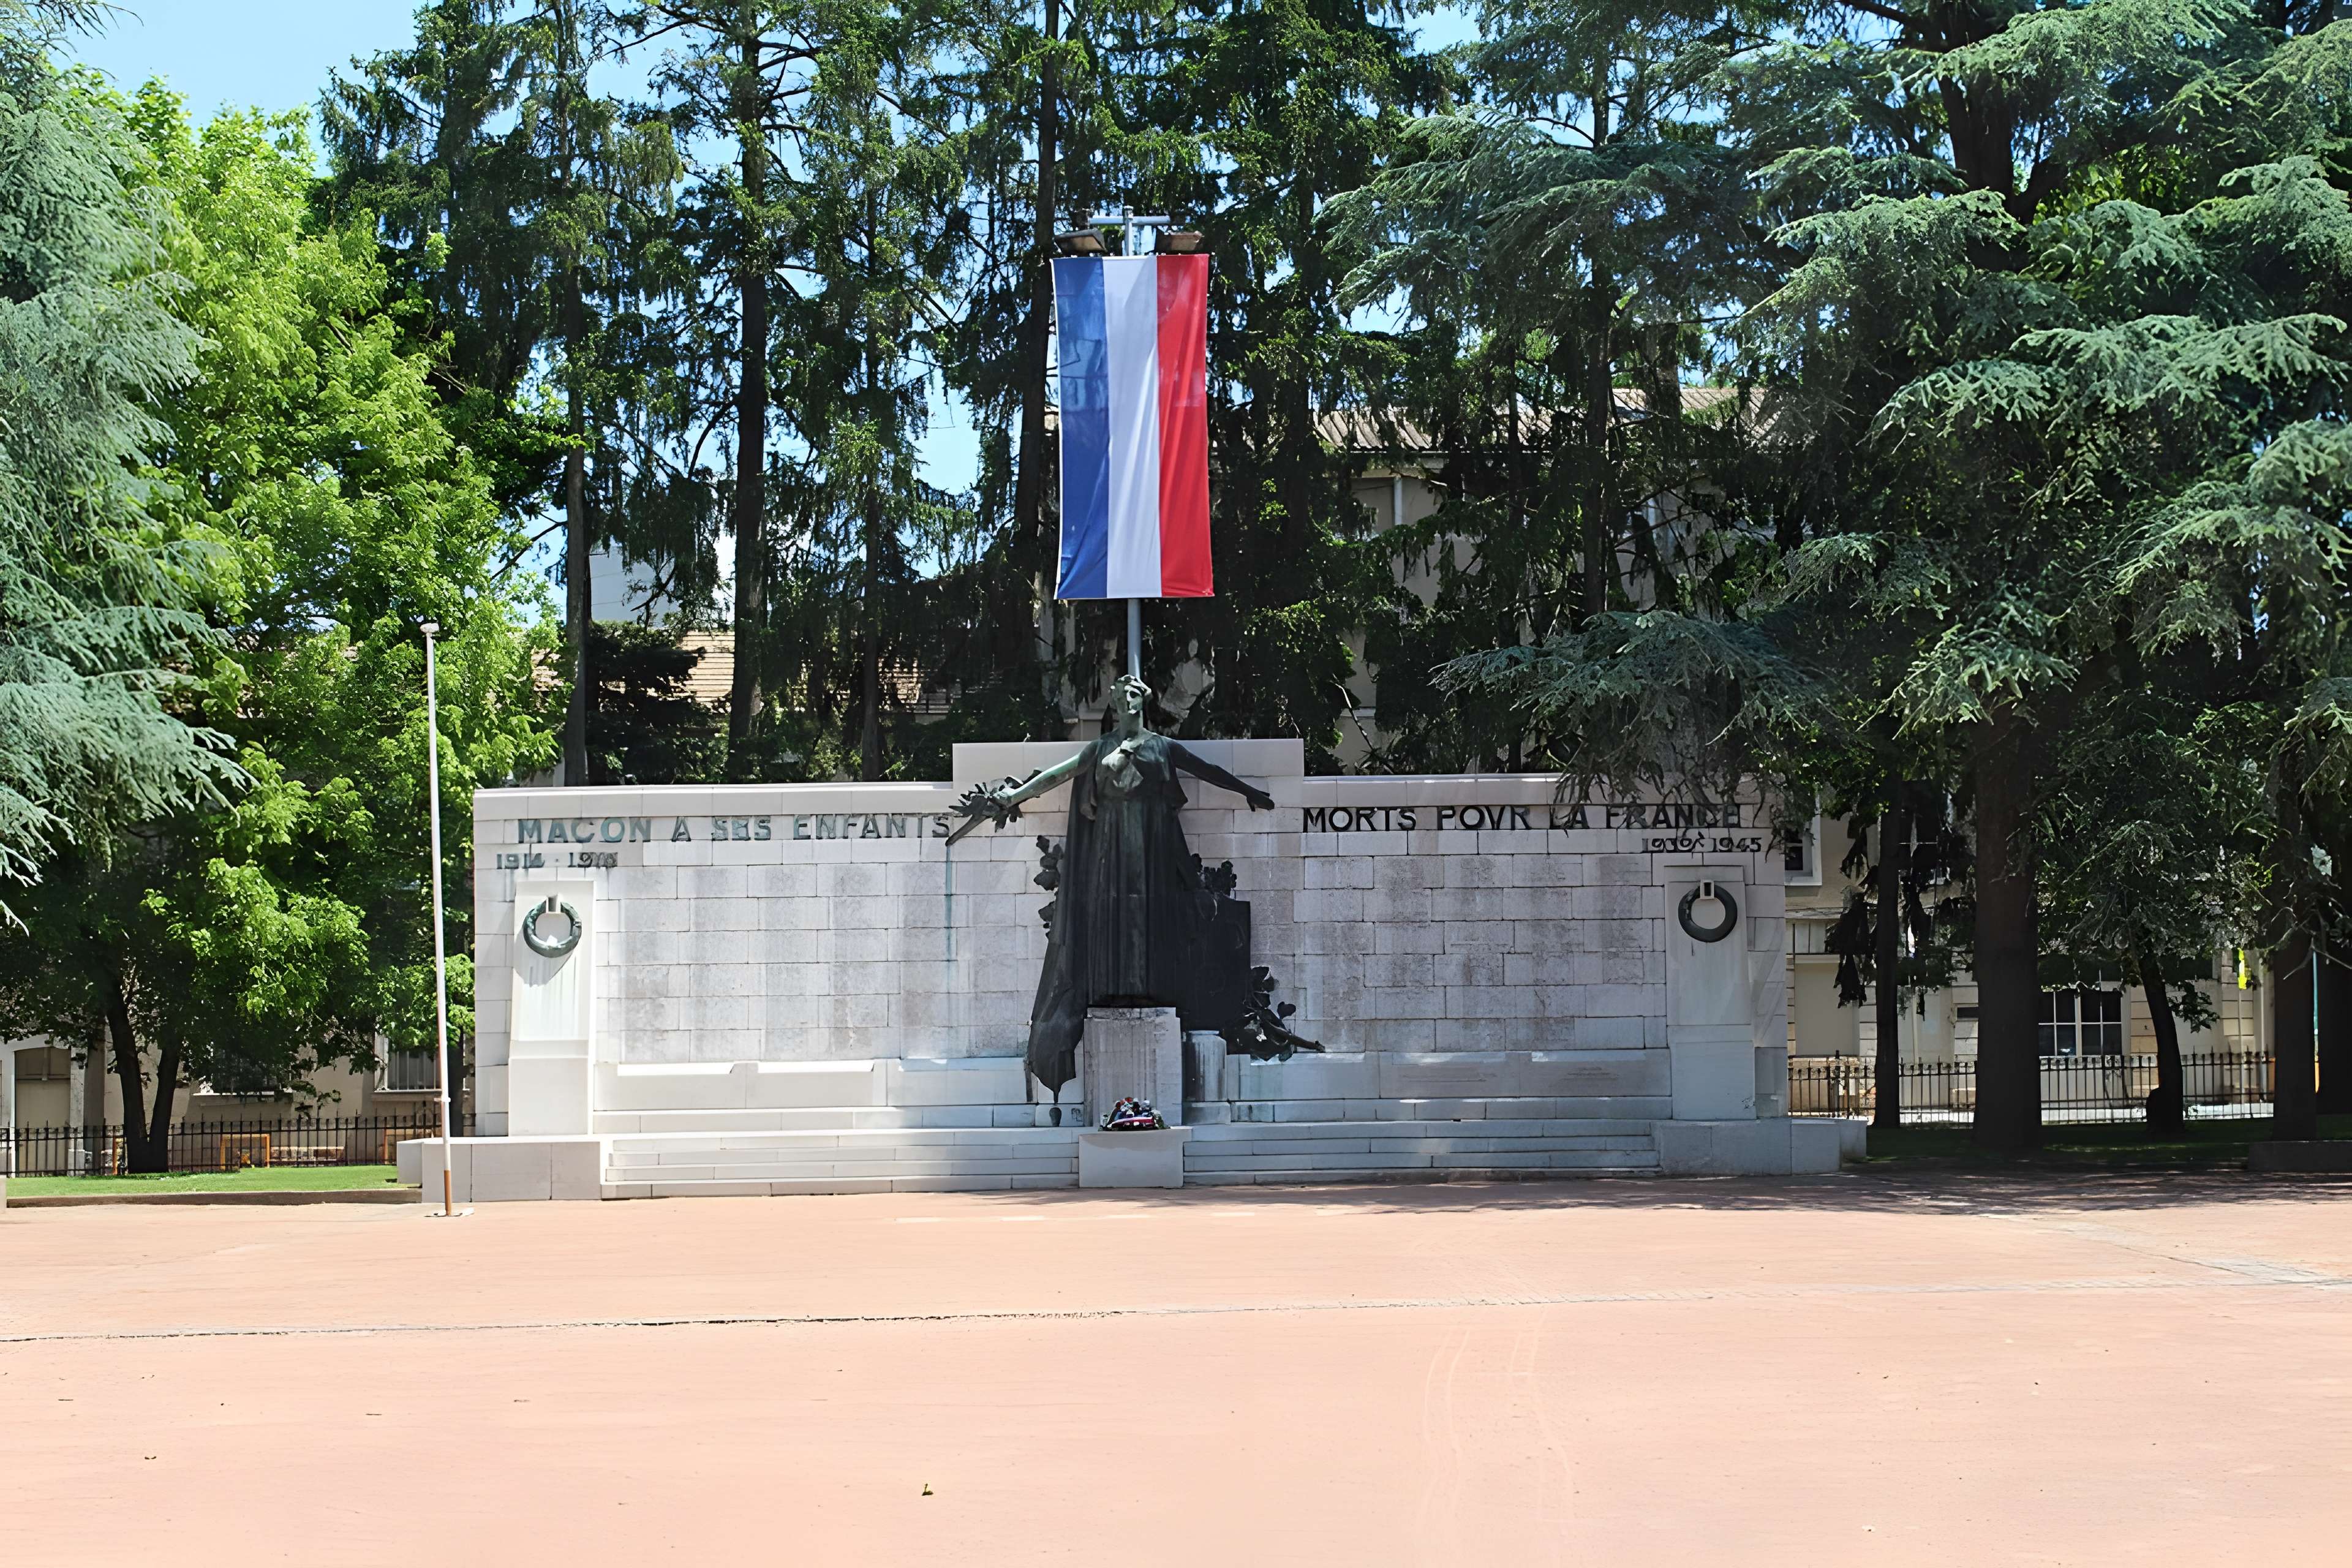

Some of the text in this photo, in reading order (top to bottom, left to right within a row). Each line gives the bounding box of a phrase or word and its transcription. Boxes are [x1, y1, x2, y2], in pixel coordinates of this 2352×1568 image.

[518, 816, 652, 843] MACON
[671, 816, 692, 843] A
[1302, 804, 1741, 833] MORTS POVR LA FRANCE
[1713, 837, 1762, 853] 1945
